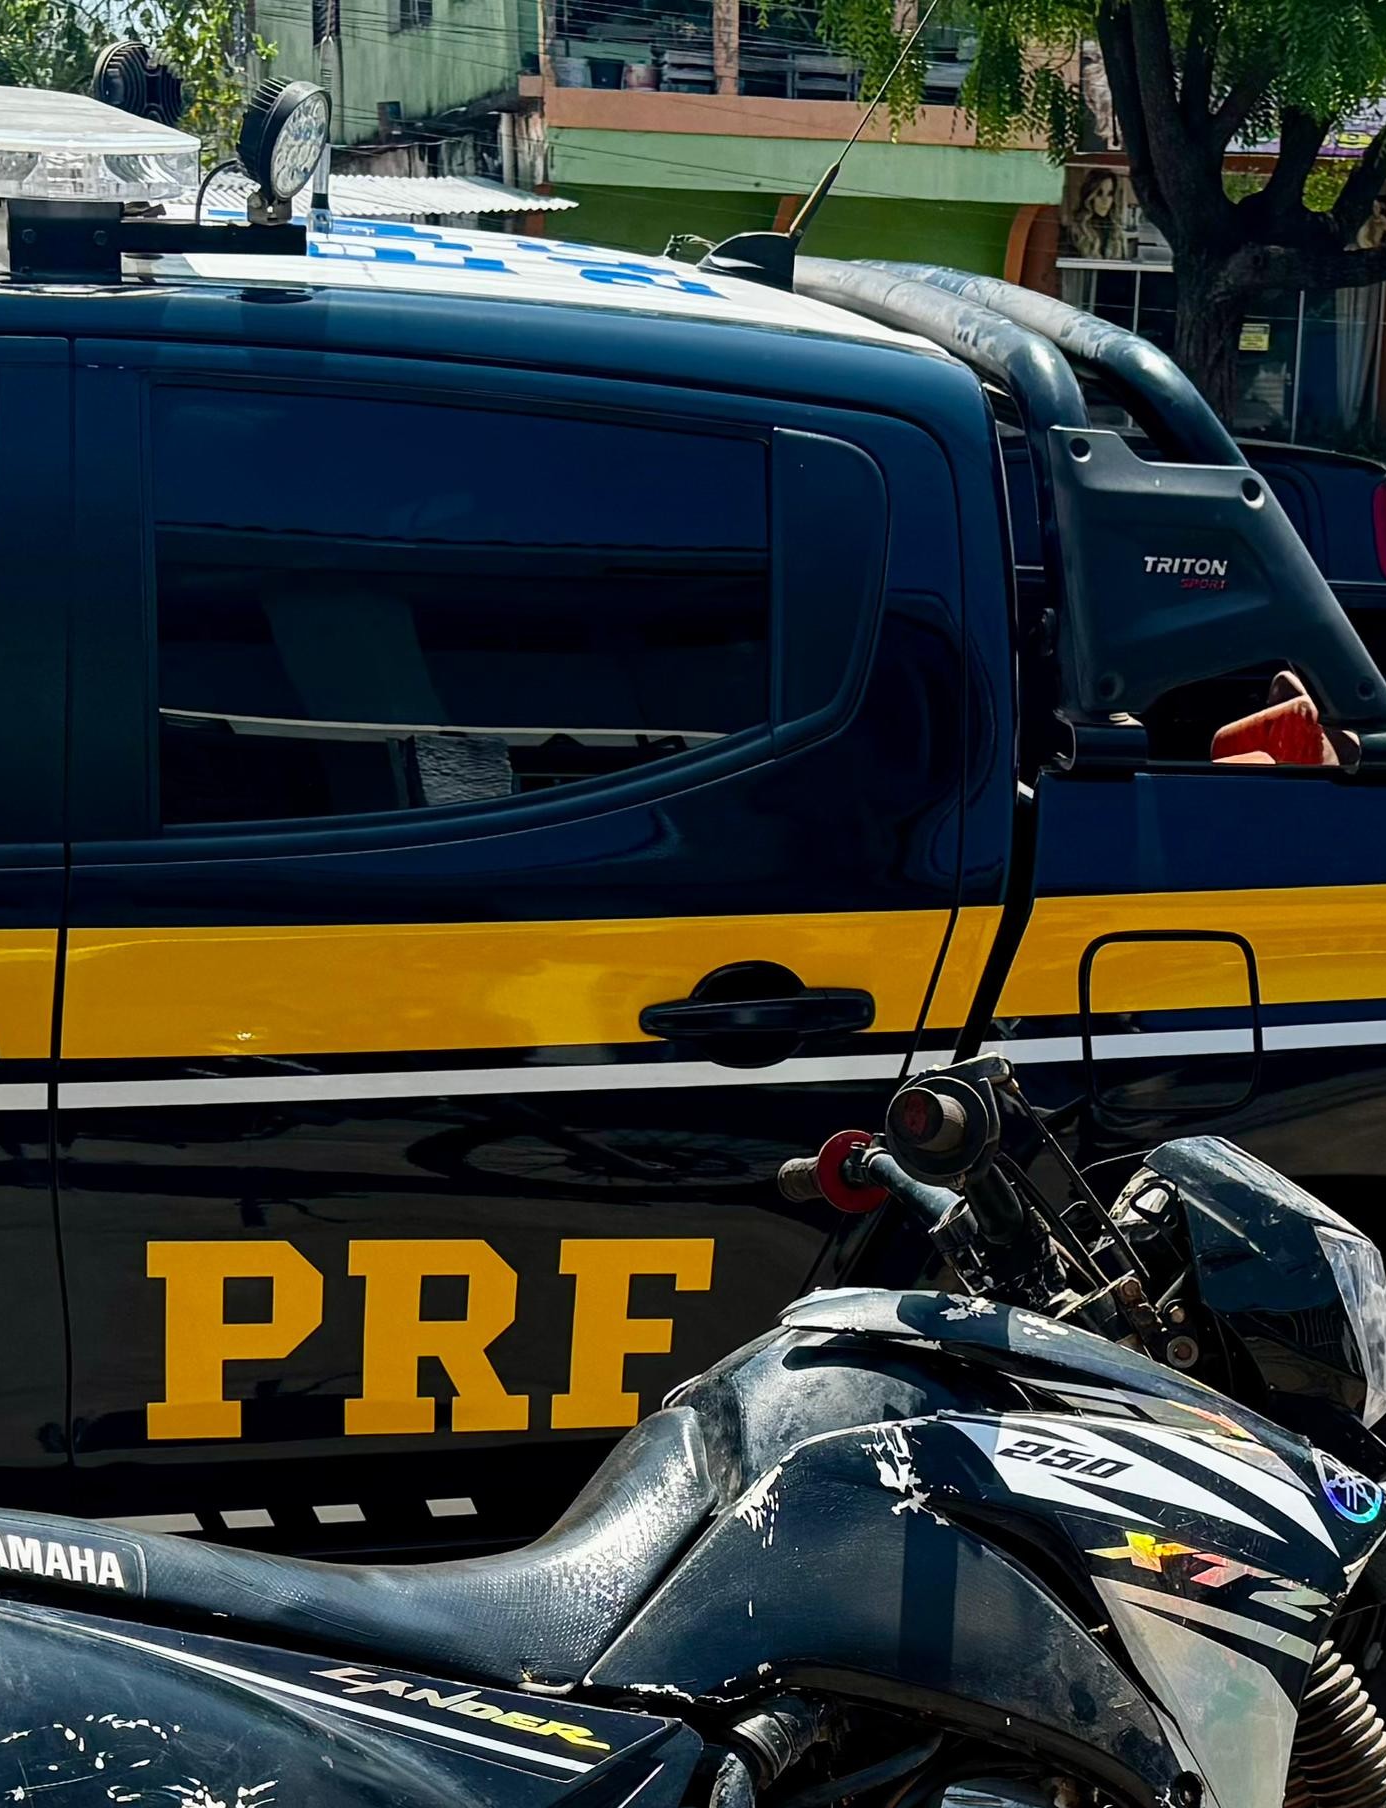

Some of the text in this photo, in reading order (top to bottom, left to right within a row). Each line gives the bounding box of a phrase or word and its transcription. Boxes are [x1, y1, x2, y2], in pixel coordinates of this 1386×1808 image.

[1144, 556, 1228, 576] TRITON
[147, 1238, 714, 1440] PRF
[996, 1440, 1135, 1479] 250
[309, 1667, 611, 1750] LANDER
